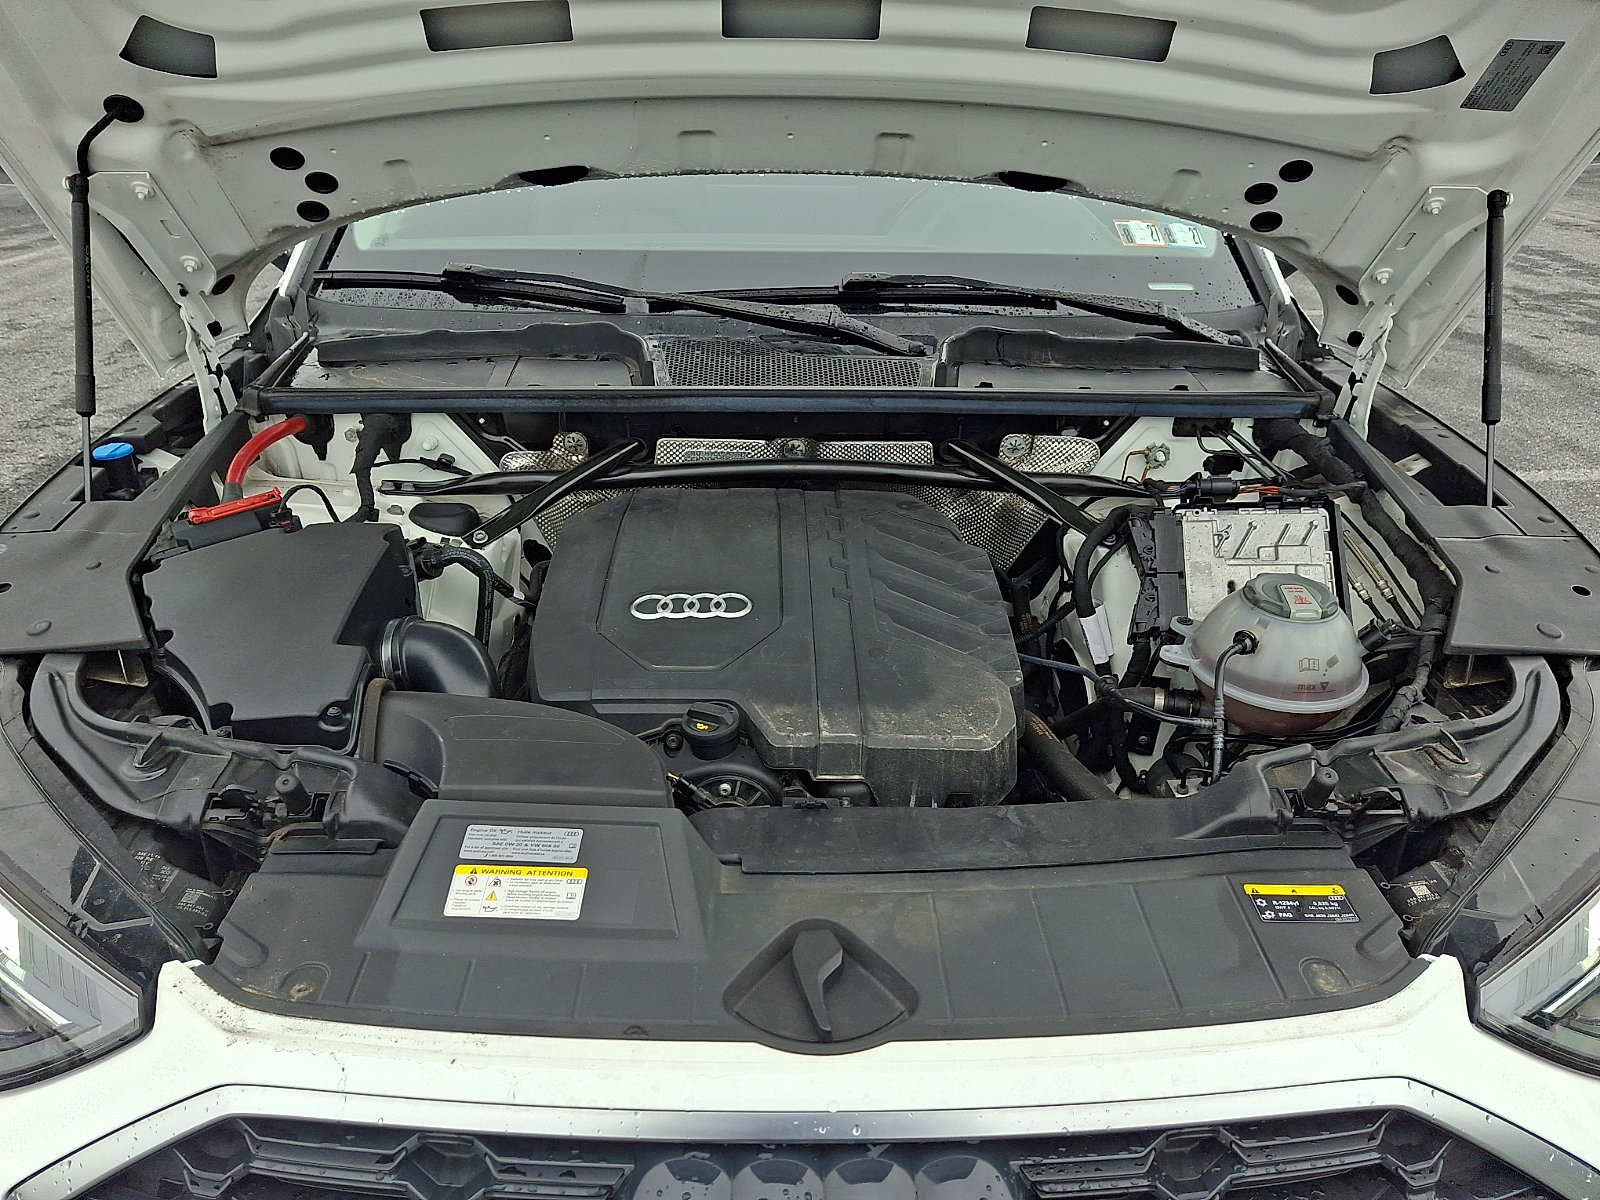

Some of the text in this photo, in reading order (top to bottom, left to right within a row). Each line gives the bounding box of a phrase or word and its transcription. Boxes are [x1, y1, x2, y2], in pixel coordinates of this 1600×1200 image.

[1146, 224, 1161, 243] 27
[1188, 227, 1203, 246] 27
[1297, 683, 1316, 691] max
[481, 868, 574, 877] WARNING ATTENTION
